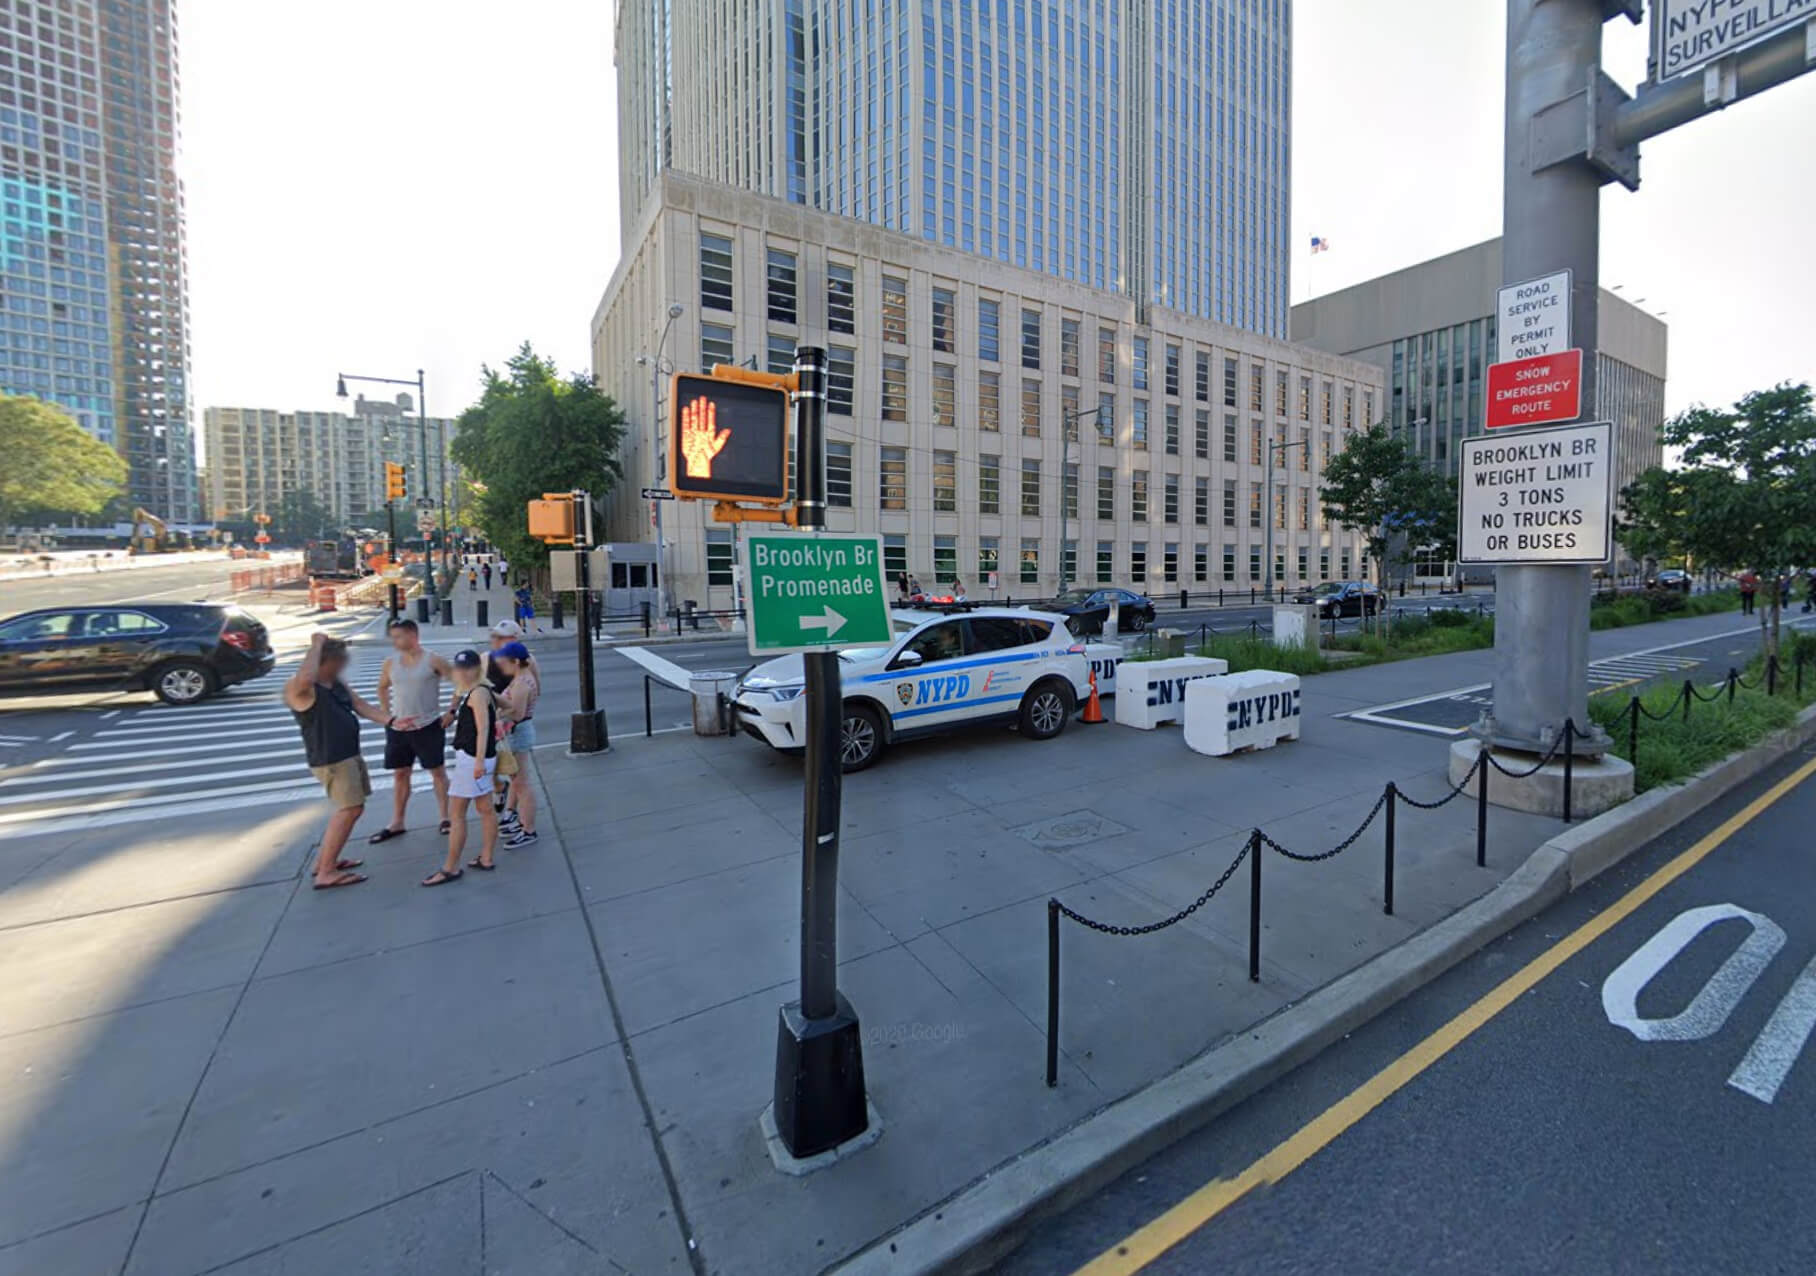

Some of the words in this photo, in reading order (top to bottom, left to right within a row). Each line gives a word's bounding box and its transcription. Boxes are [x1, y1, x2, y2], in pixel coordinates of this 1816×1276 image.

[1668, 0, 1816, 67] SURVEILLA
[1517, 283, 1549, 299] ROAD
[1508, 295, 1558, 316] SERVICE
[1524, 315, 1541, 327] BY
[1511, 327, 1554, 344] PERMIT
[1515, 344, 1549, 359] ONLY
[1516, 366, 1550, 381] SNOW
[1496, 380, 1571, 400] EMERGENCY
[1512, 401, 1552, 414] ROUTE
[1473, 442, 1562, 465] BROOKLYN
[1572, 438, 1597, 456] BR
[1475, 466, 1537, 486] WEIGHT
[1546, 462, 1594, 481] LIMIT
[1499, 492, 1508, 507] 3
[1518, 487, 1565, 505] TONS
[1482, 513, 1504, 529] NO
[1513, 509, 1583, 526] TRUCKS
[1487, 535, 1508, 550] OR
[1517, 532, 1577, 549] BUSES
[755, 544, 847, 572] Brooklyn
[854, 545, 874, 566] Br
[762, 575, 873, 598] Promenade
[916, 675, 970, 705] NYPD
[1238, 692, 1292, 729] NYPD
